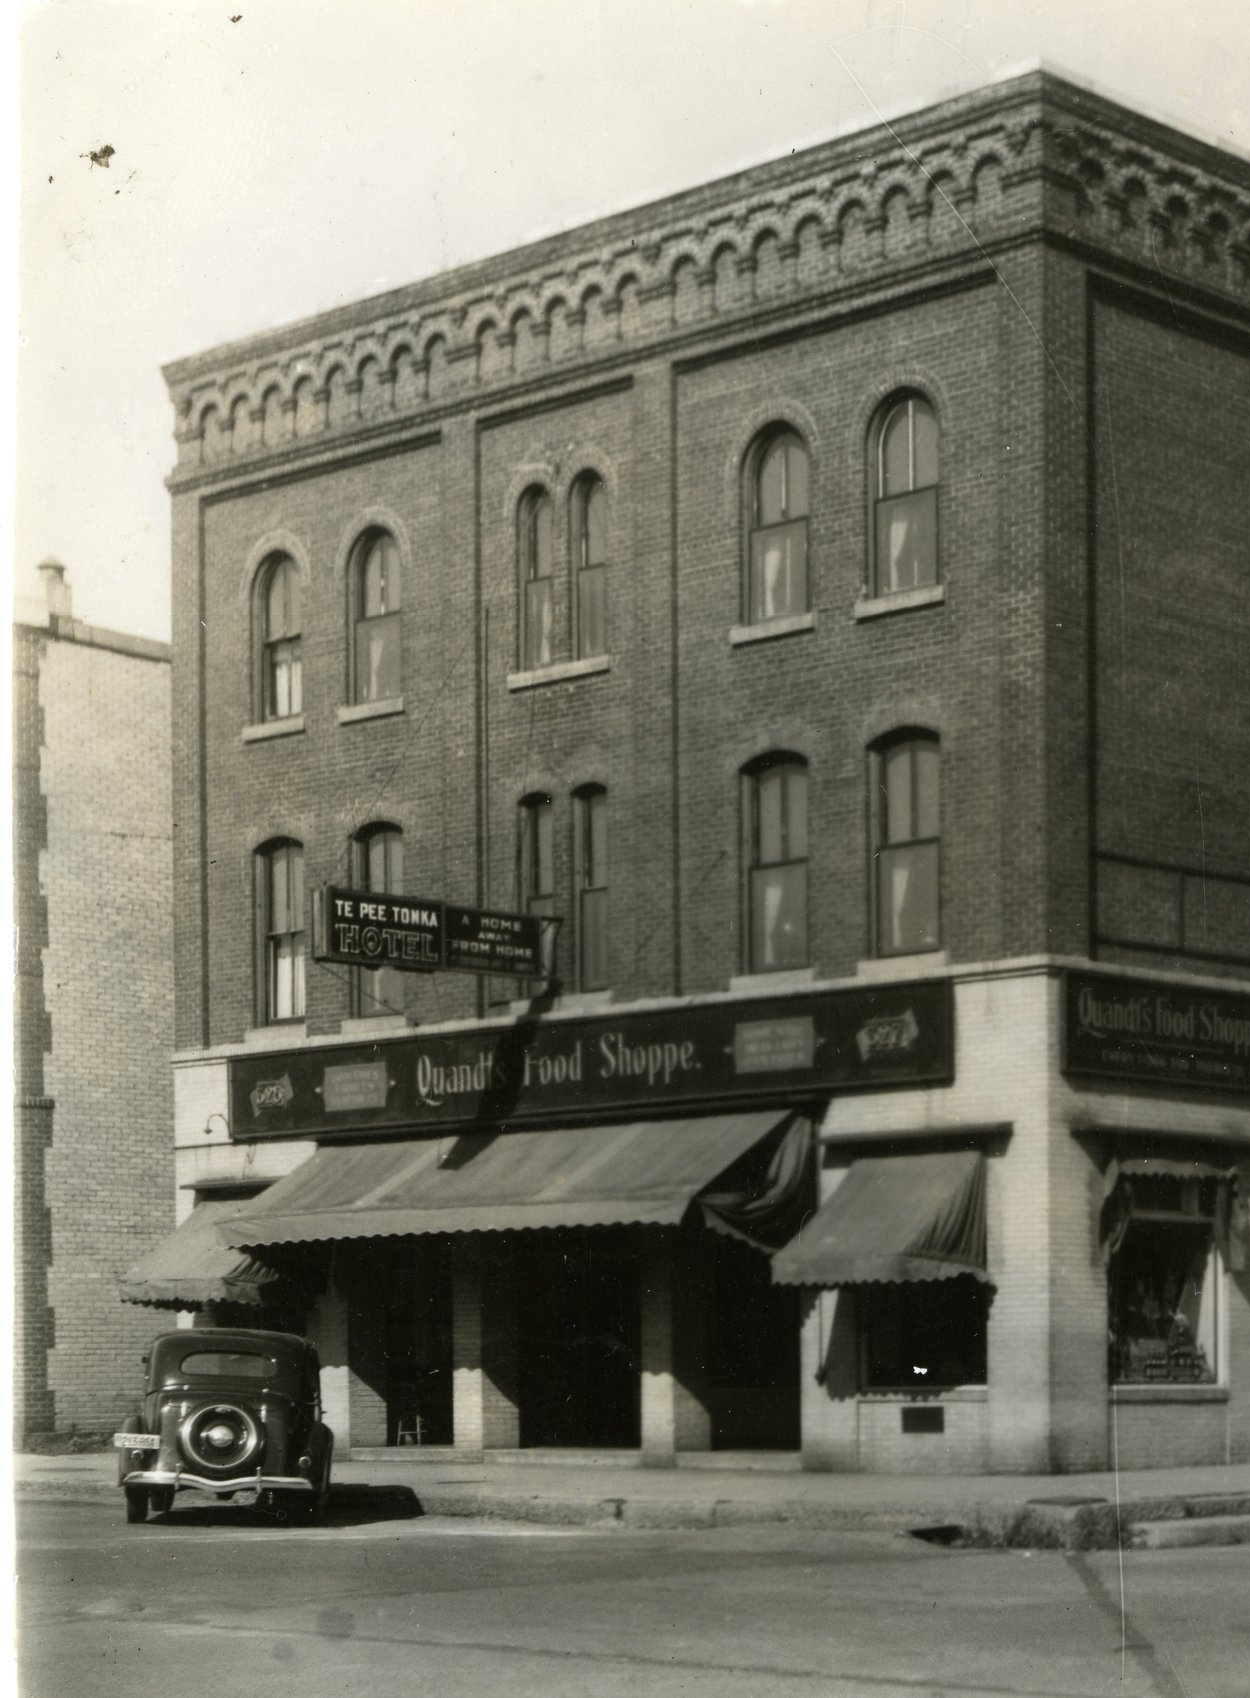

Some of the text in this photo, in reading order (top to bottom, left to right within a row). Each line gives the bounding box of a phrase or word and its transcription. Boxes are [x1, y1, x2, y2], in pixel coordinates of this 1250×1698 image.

[335, 899, 438, 928] TE PEE TONKA
[461, 914, 521, 932] A HOME
[335, 923, 439, 962] HOTEL
[452, 939, 533, 959] FROM HOME
[477, 931, 511, 942] AWAY
[1076, 987, 1153, 1039] Quandt's
[1155, 998, 1195, 1039] Food
[415, 1051, 507, 1107] Quandts
[523, 1040, 582, 1087] Food
